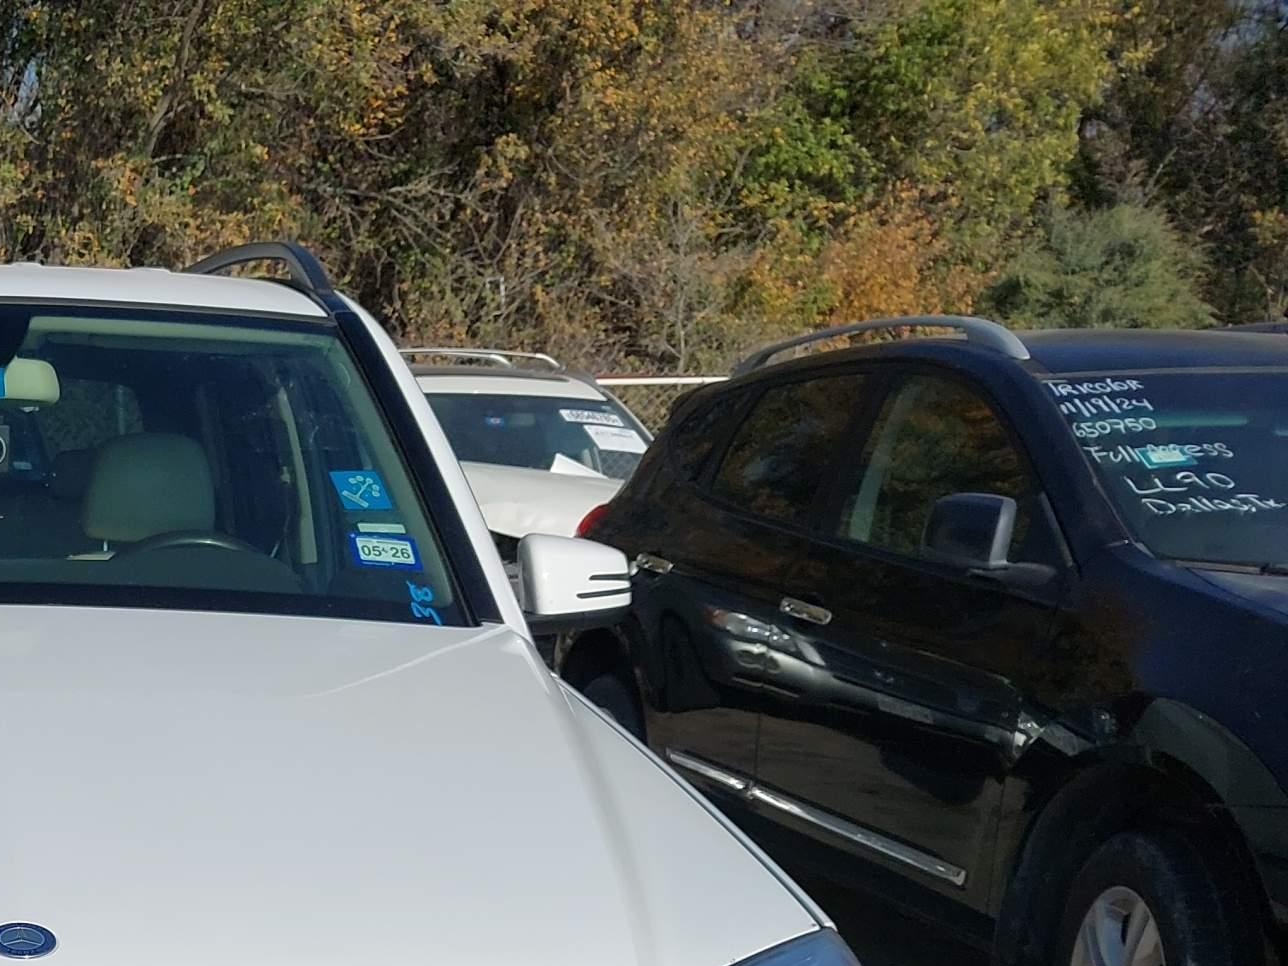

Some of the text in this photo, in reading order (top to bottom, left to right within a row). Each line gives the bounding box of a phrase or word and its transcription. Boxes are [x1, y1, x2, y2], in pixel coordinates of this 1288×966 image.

[1059, 395, 1154, 417] 11/19/24
[1071, 417, 1157, 438] 650750
[1083, 445, 1140, 464] Full
